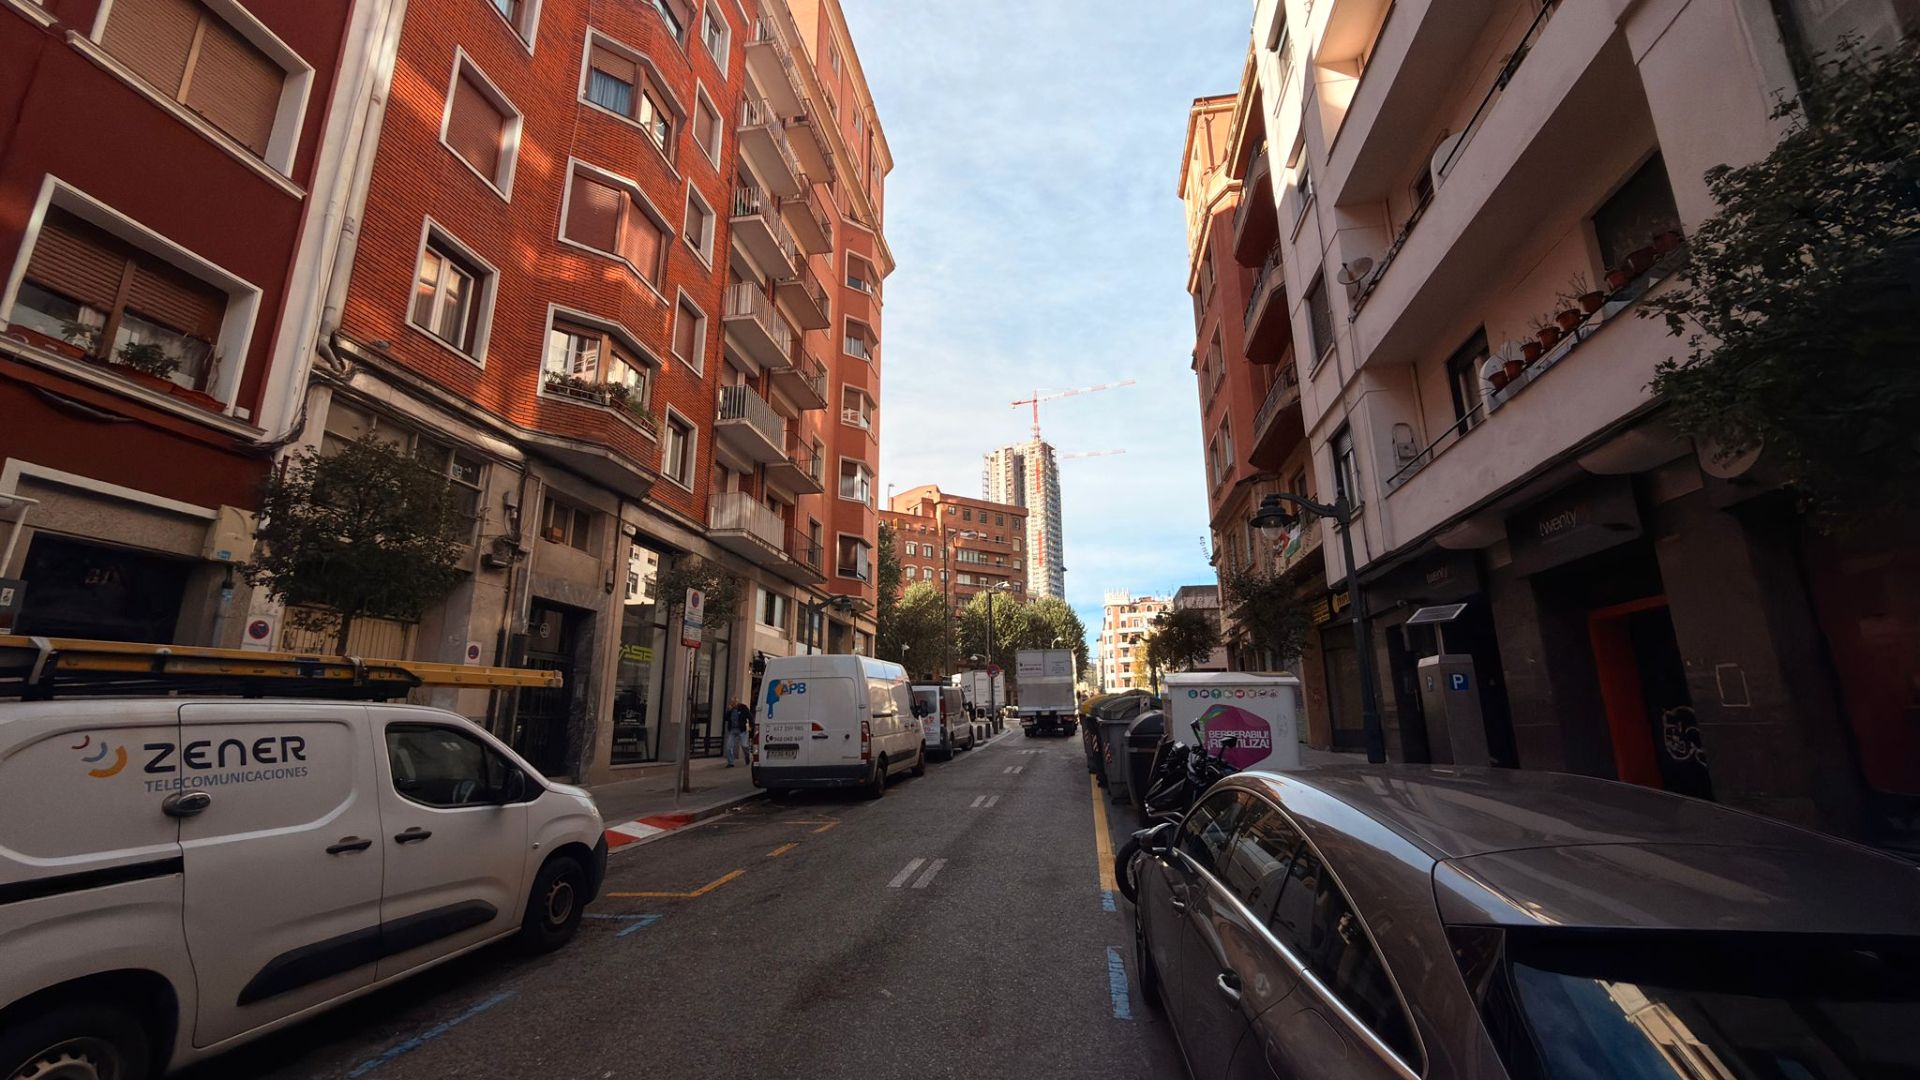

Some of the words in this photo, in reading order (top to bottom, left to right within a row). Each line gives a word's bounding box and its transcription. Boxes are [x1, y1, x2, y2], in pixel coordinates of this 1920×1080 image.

[782, 682, 807, 695] APB
[1452, 674, 1464, 690] P
[1207, 738, 1270, 750] ¡RETILIZA!
[143, 735, 307, 774] ZENER
[144, 766, 308, 793] TELECOMUNICACIONES
